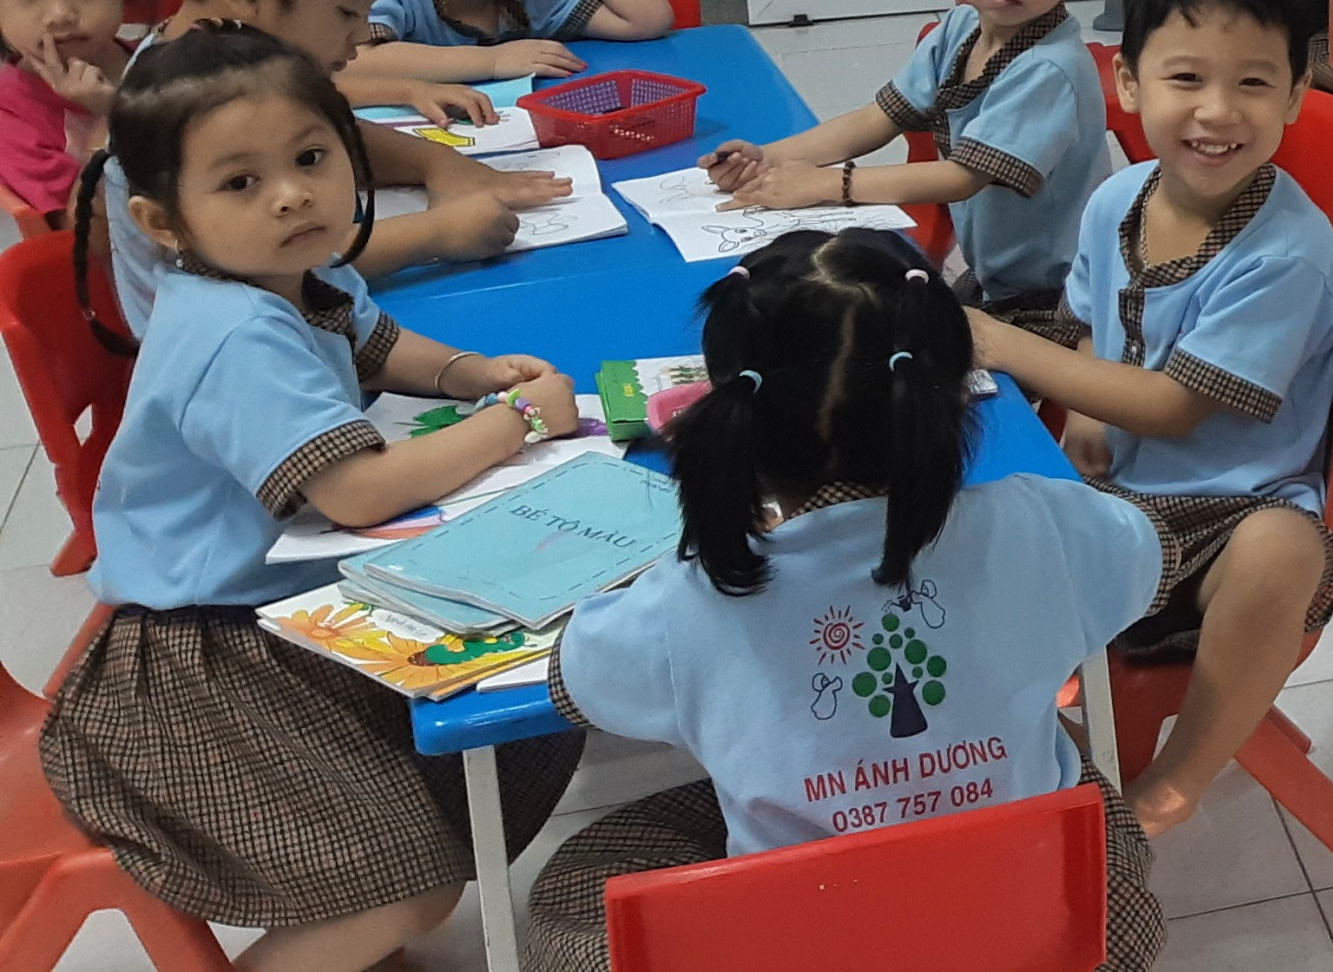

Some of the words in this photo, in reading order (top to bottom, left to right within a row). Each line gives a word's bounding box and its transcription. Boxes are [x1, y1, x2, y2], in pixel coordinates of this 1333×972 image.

[510, 504, 549, 522] BÉ
[545, 514, 581, 533] TÔ
[577, 527, 638, 548] MÀU
[804, 770, 847, 803] MN
[854, 757, 910, 792] ÁNH
[918, 735, 1009, 779] DƯƠNG
[832, 801, 888, 833] 0387
[896, 790, 942, 819] 757
[950, 777, 994, 807] 084
